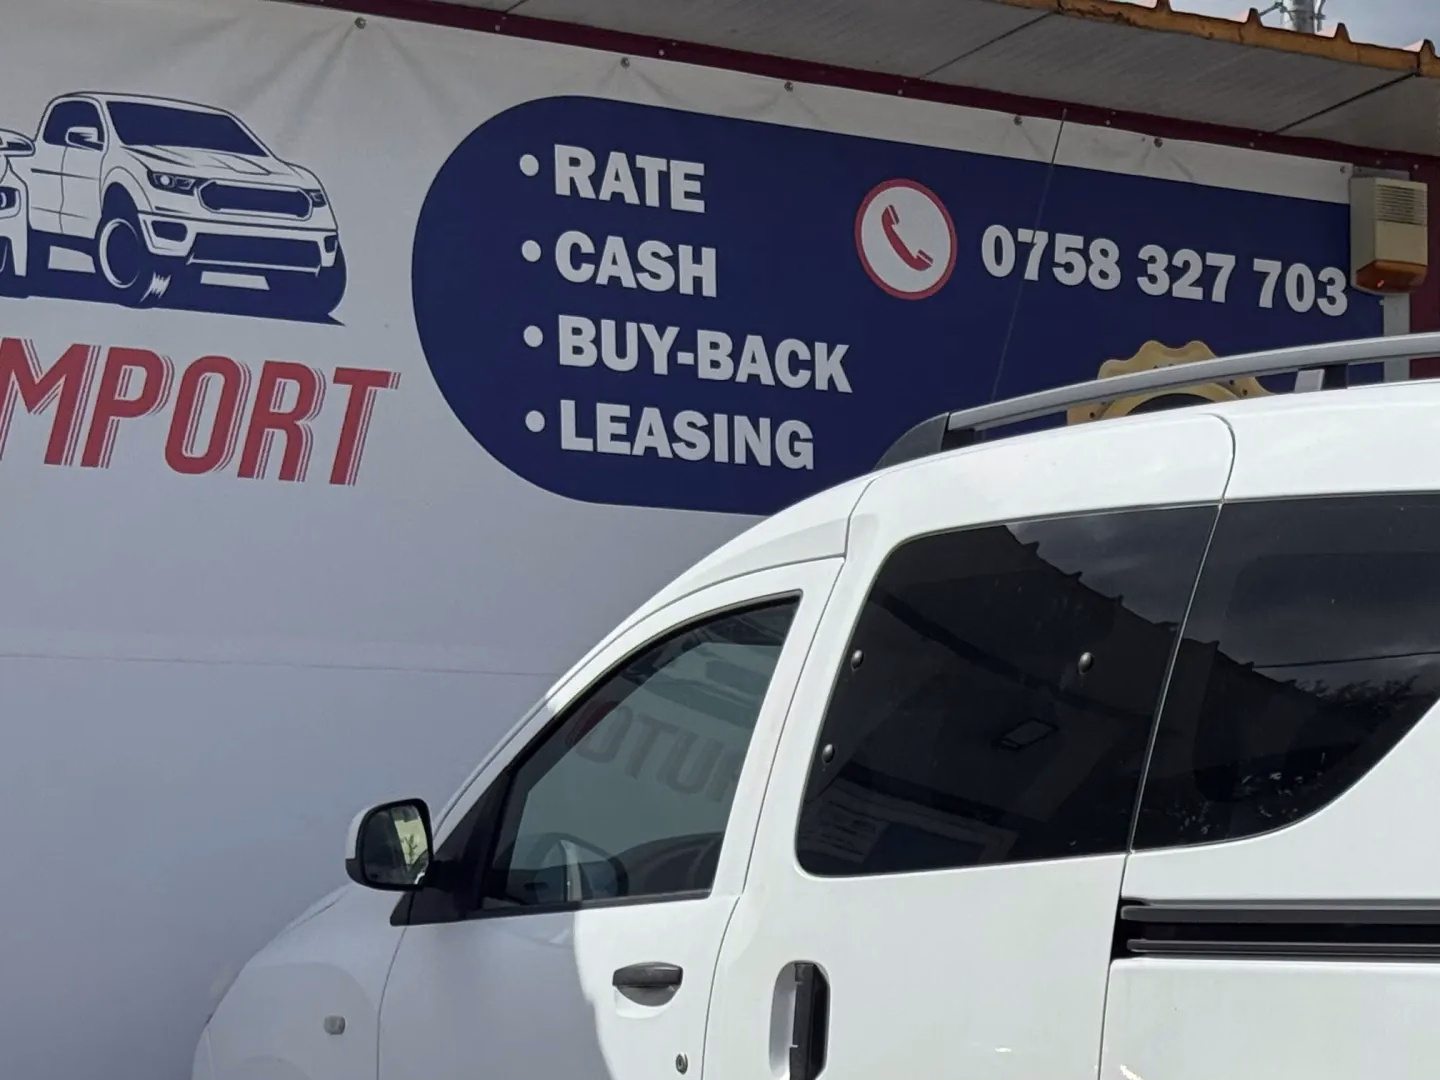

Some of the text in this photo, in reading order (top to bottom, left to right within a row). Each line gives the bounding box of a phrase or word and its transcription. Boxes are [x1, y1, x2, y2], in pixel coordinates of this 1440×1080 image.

[554, 144, 705, 213] RATE
[555, 231, 717, 297] CASH
[981, 224, 1348, 316] 0758 327 703
[558, 314, 852, 393] BUY-BACK
[560, 399, 814, 470] LEASING
